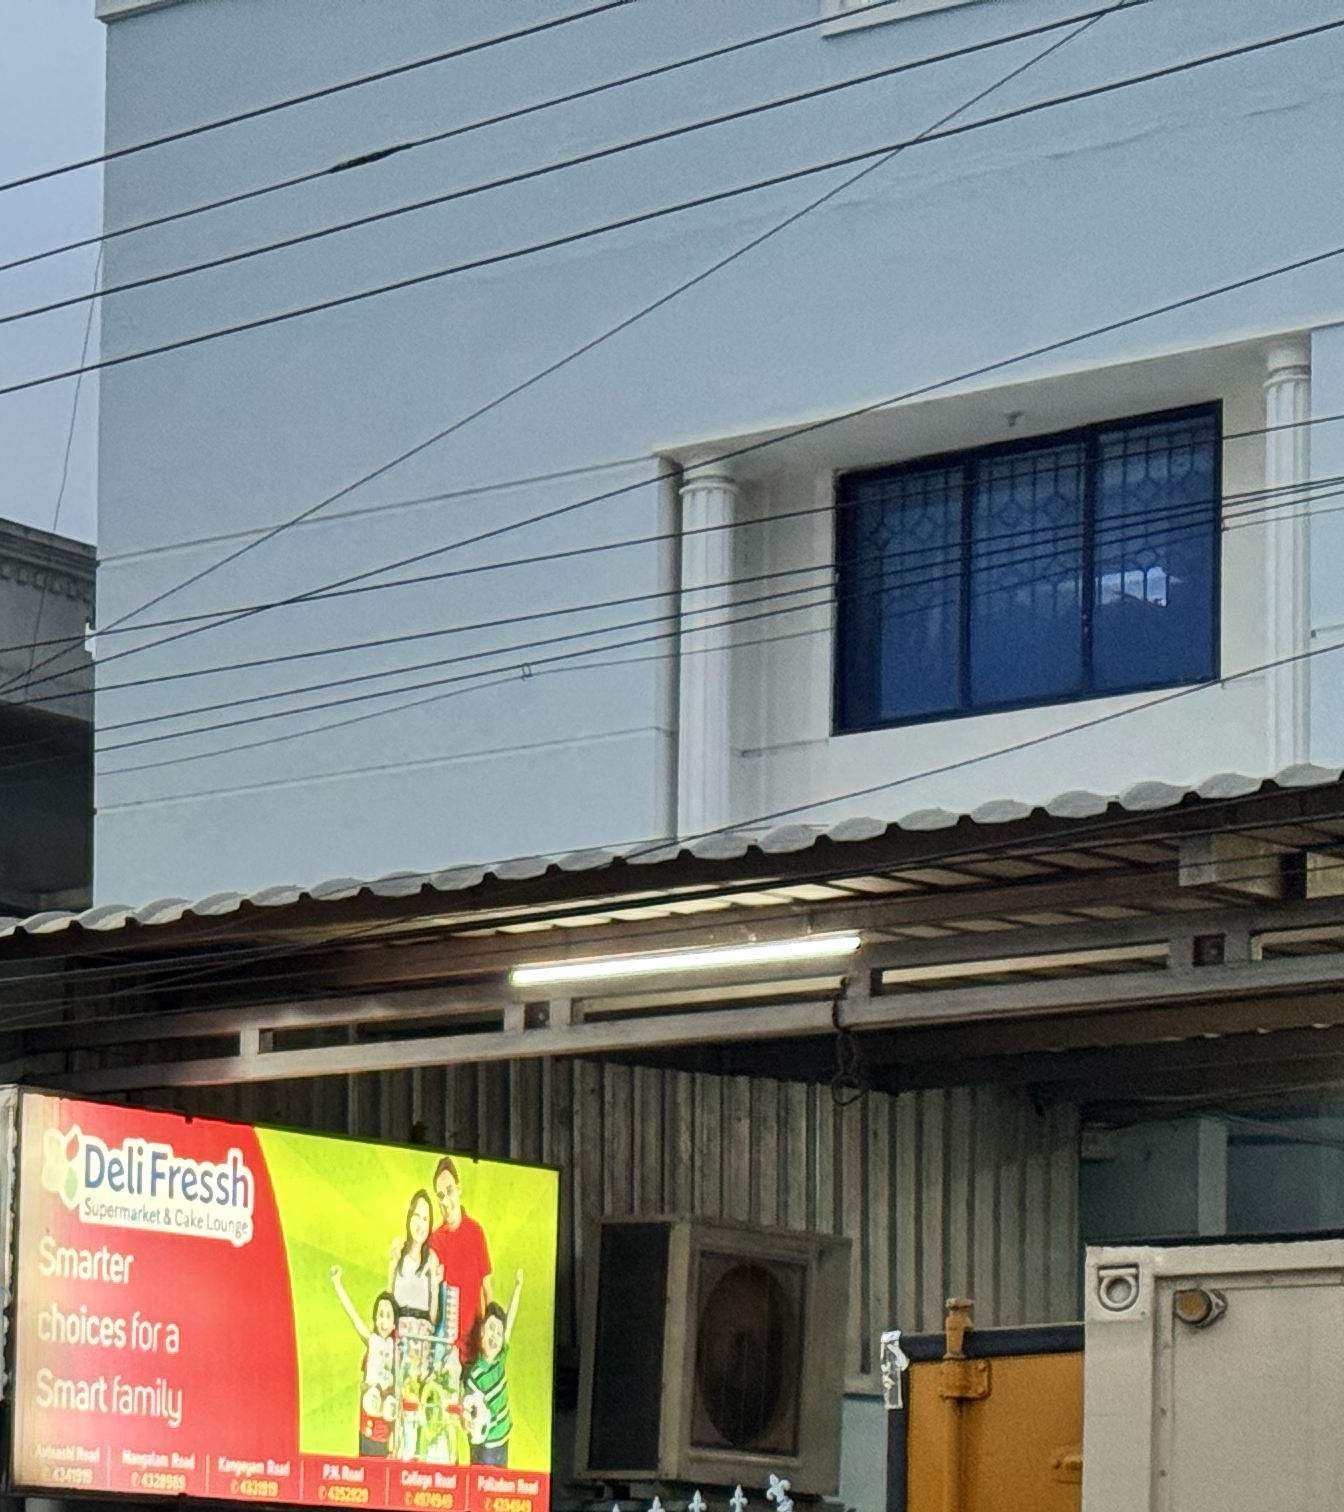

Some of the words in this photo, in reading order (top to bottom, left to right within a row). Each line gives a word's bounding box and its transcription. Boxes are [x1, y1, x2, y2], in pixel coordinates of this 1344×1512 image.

[84, 1197, 161, 1225] Supermarket
[163, 1209, 172, 1225] &
[175, 1209, 203, 1230] Cake
[207, 1216, 248, 1239] Lounge
[38, 1235, 134, 1284] Smarter
[37, 1302, 127, 1349] choices
[131, 1310, 162, 1353] for
[165, 1323, 180, 1354] a
[35, 1367, 108, 1413] Smart
[111, 1374, 183, 1428] family
[267, 1458, 291, 1477] Road
